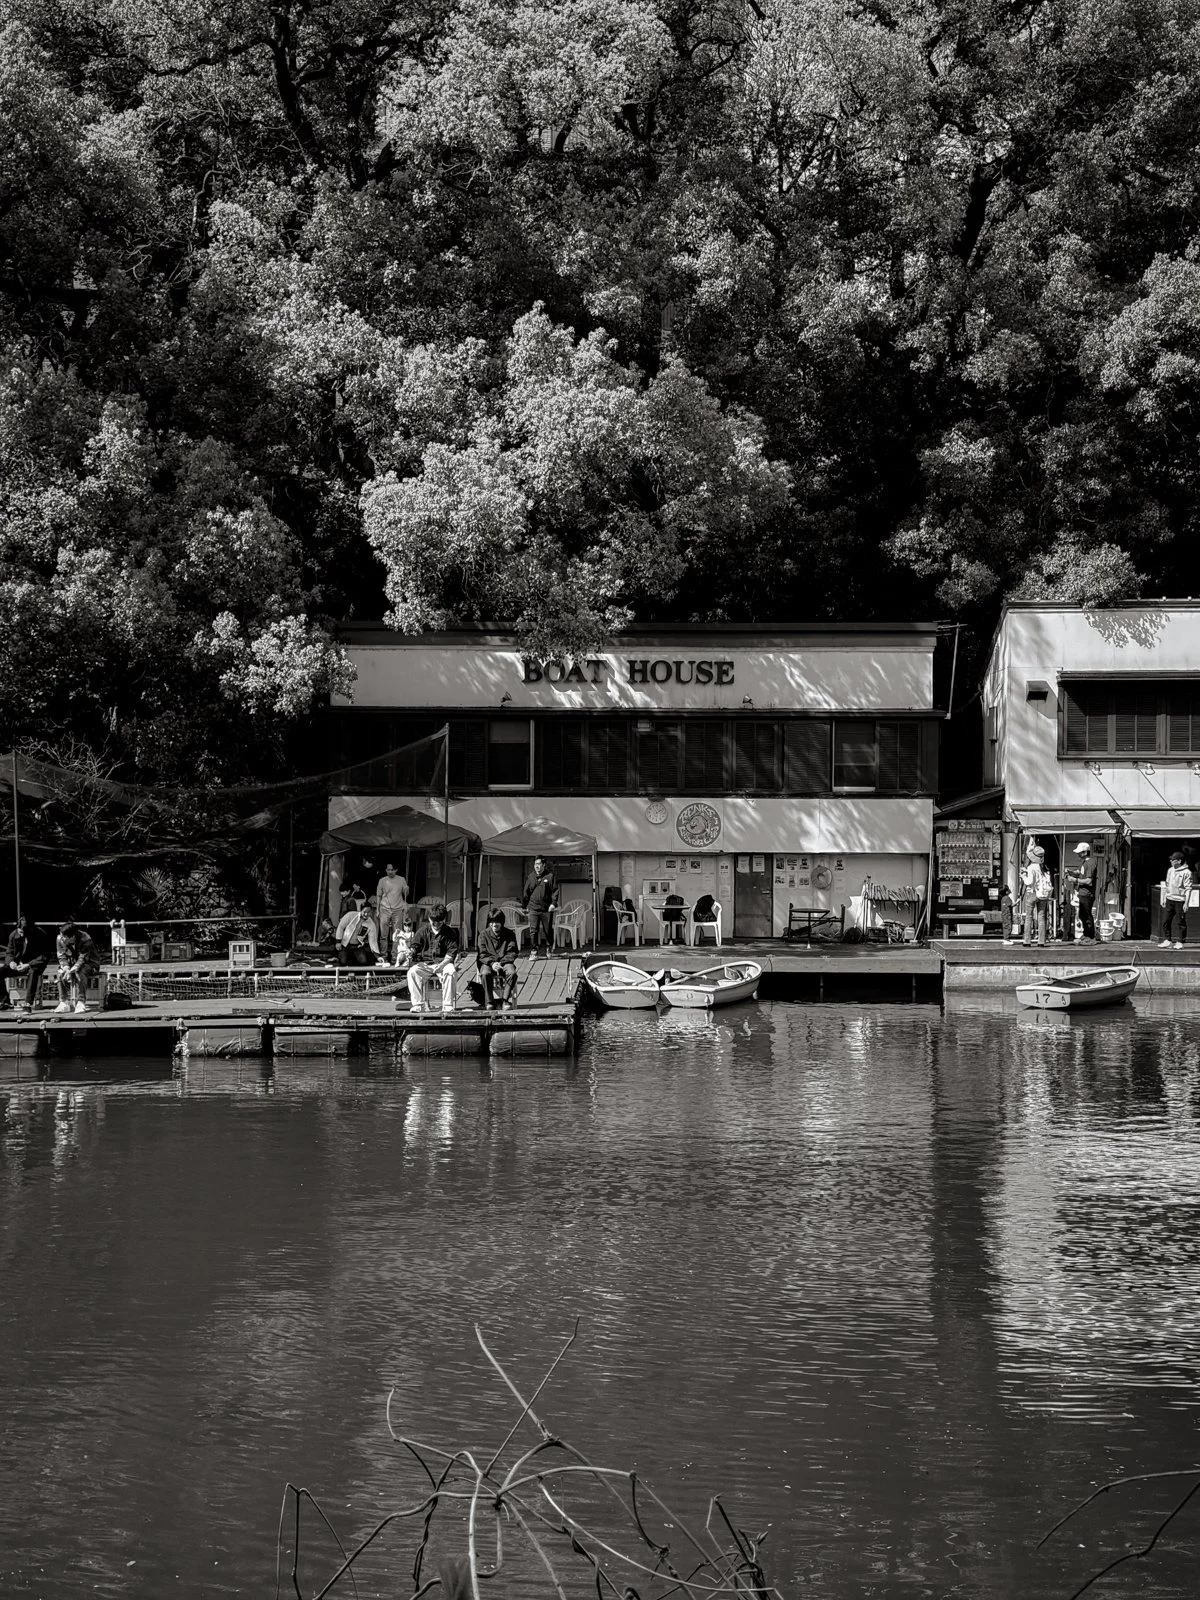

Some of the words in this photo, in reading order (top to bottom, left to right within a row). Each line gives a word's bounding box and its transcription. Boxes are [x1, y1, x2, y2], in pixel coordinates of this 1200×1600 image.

[522, 659, 607, 683] BOAT
[627, 660, 735, 685] HOUSE
[1035, 993, 1051, 1004] 17
